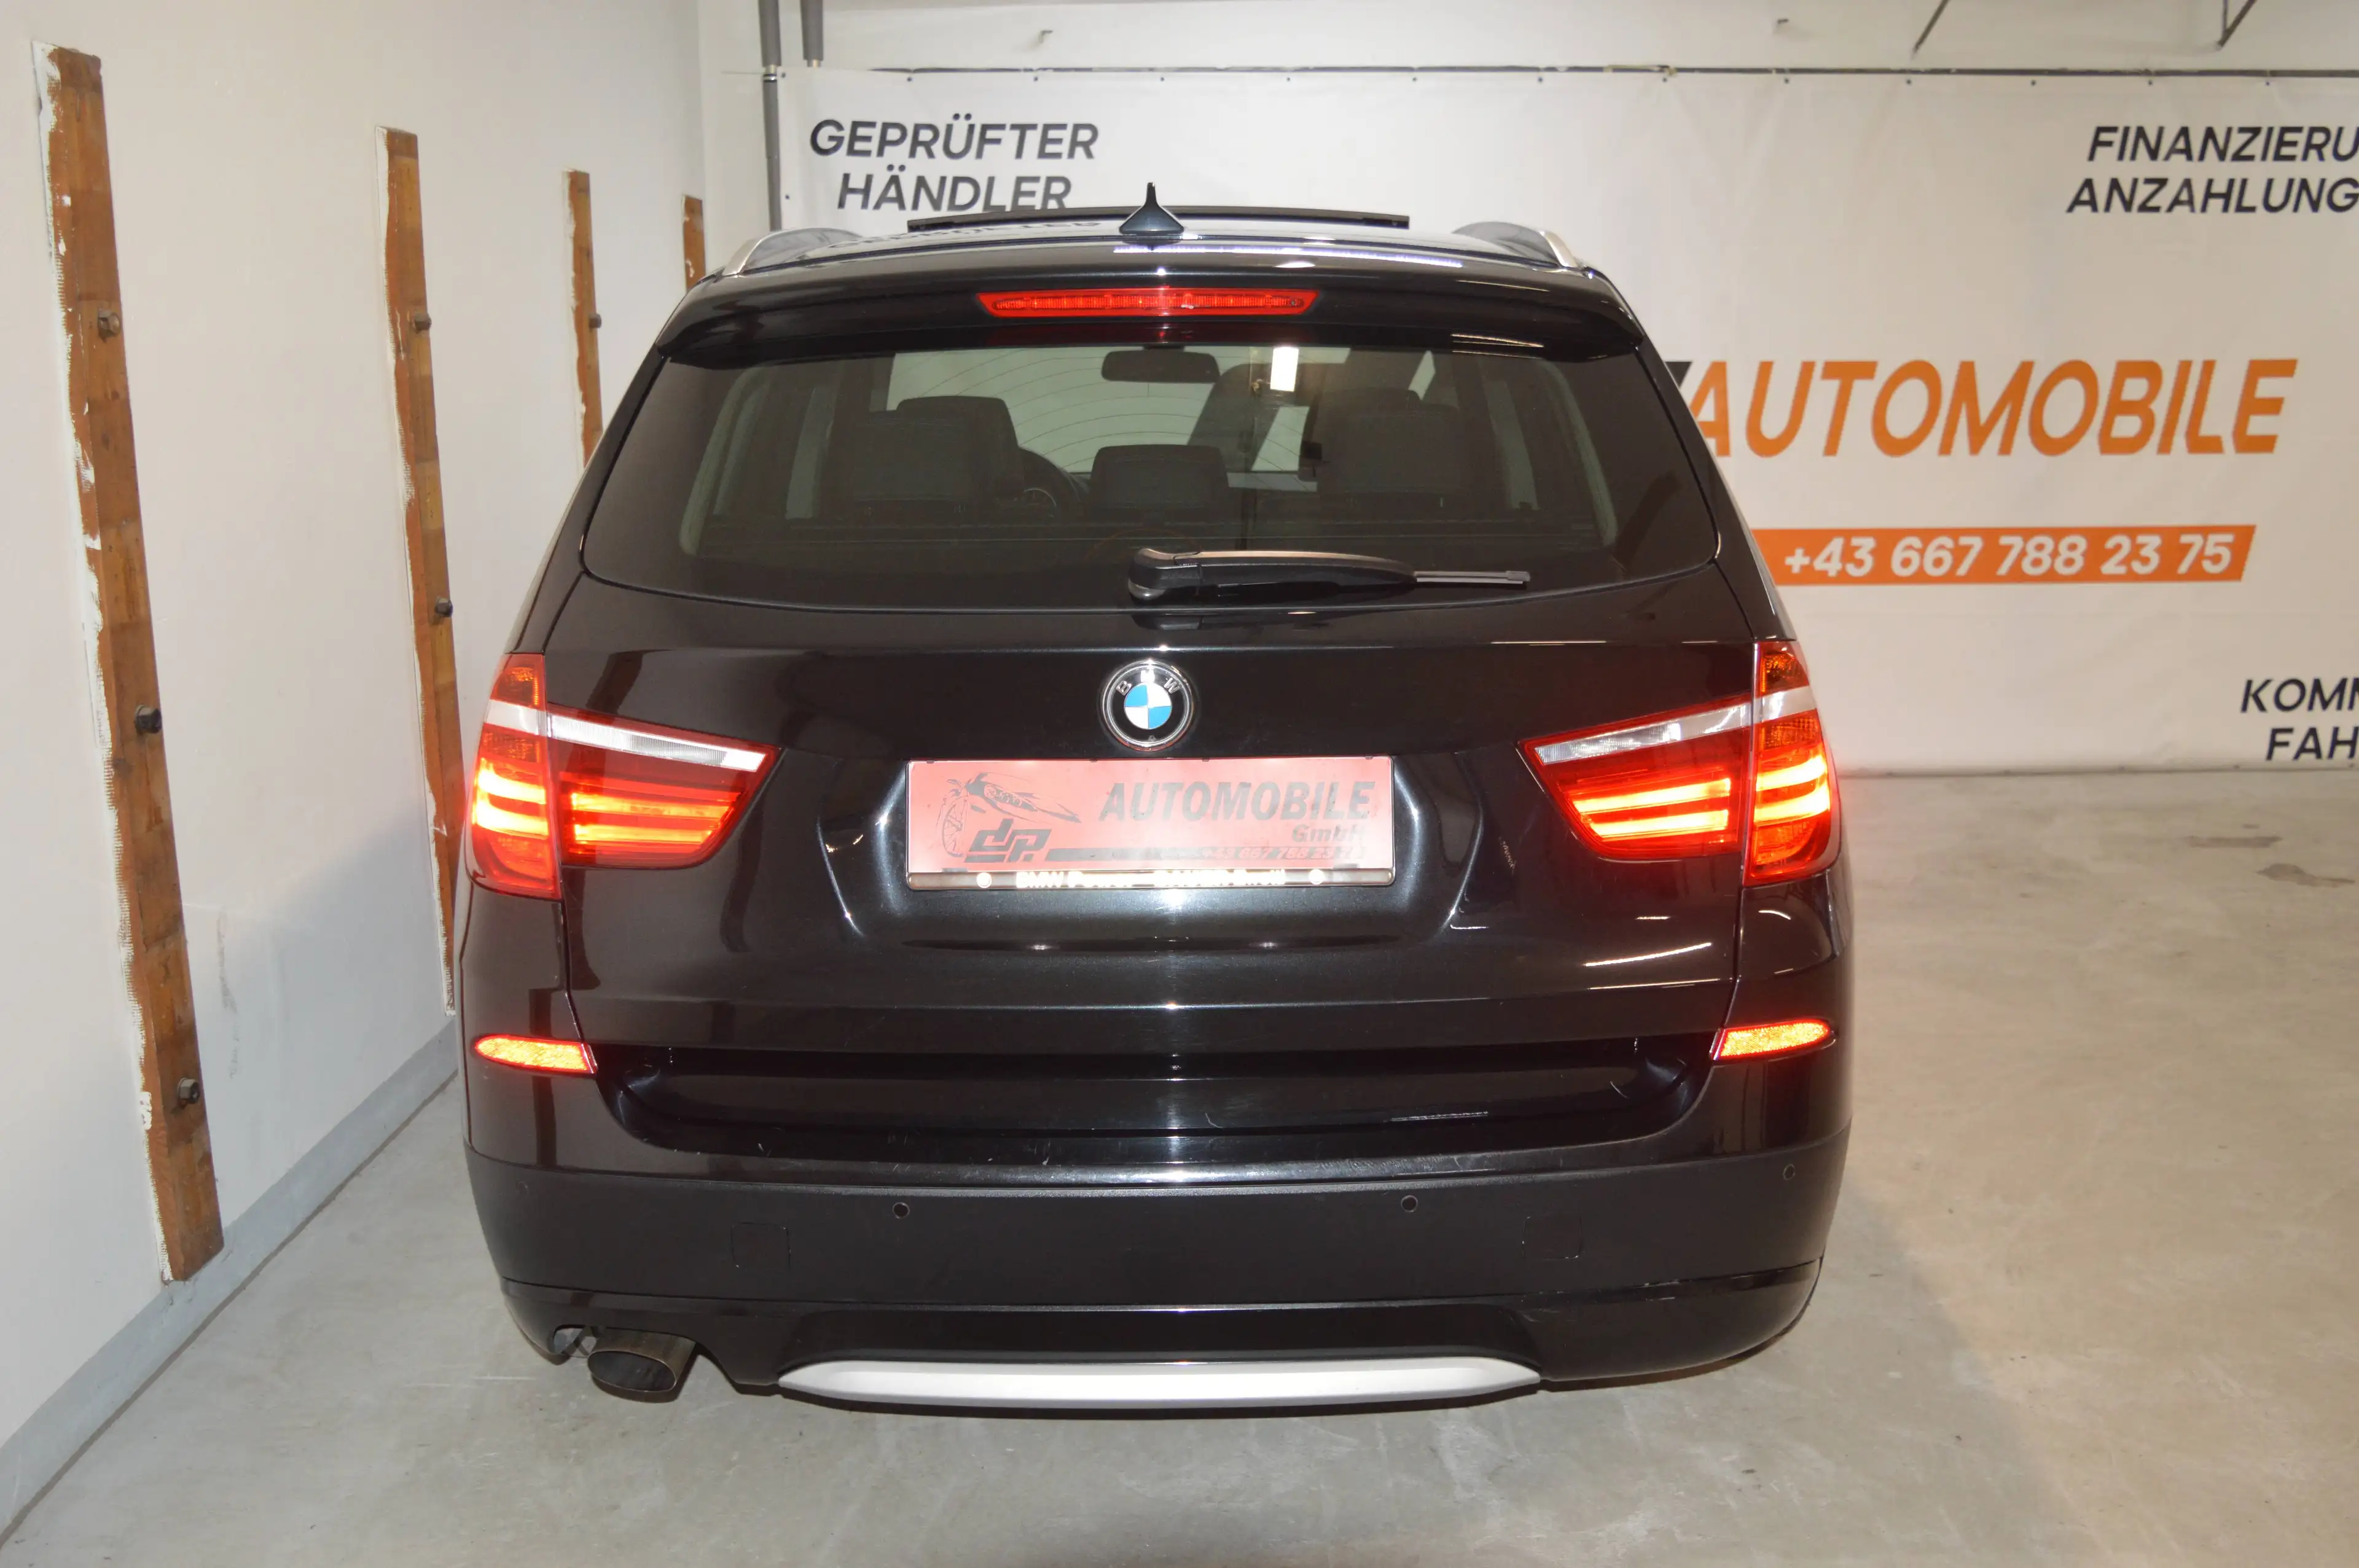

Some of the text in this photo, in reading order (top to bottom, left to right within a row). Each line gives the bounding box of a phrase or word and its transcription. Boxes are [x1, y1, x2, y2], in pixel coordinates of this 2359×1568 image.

[809, 113, 1098, 160] GEPRÜFTER
[2087, 125, 2359, 162] FINANZIERU
[837, 164, 1072, 211] HÄNDLER
[2066, 177, 2359, 213] ANZAHLUNG
[1689, 359, 2297, 457] AUTOMOBILE
[1785, 533, 2235, 577] +43 667 788 23 75
[2240, 677, 2359, 712] KOM
[2266, 726, 2359, 761] FAH
[1098, 781, 1375, 821] AUTOMOBILE
